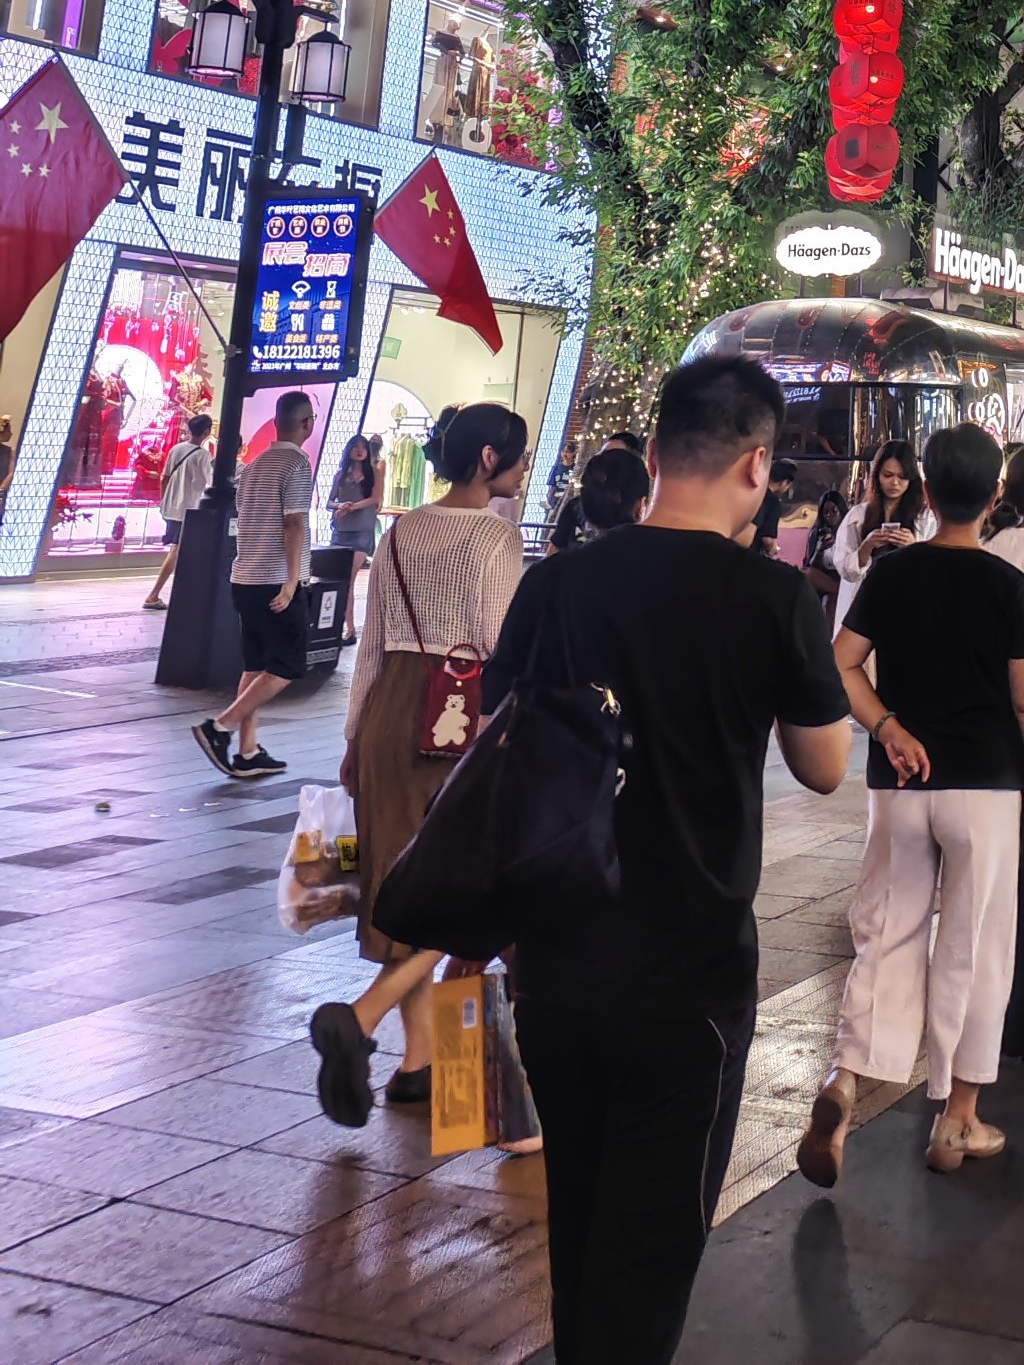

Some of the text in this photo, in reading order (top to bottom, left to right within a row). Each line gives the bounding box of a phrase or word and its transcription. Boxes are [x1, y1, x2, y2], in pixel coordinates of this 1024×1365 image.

[262, 241, 351, 278] 展会 招商
[259, 290, 281, 333] 诚邀
[262, 344, 341, 359] 18122181396
